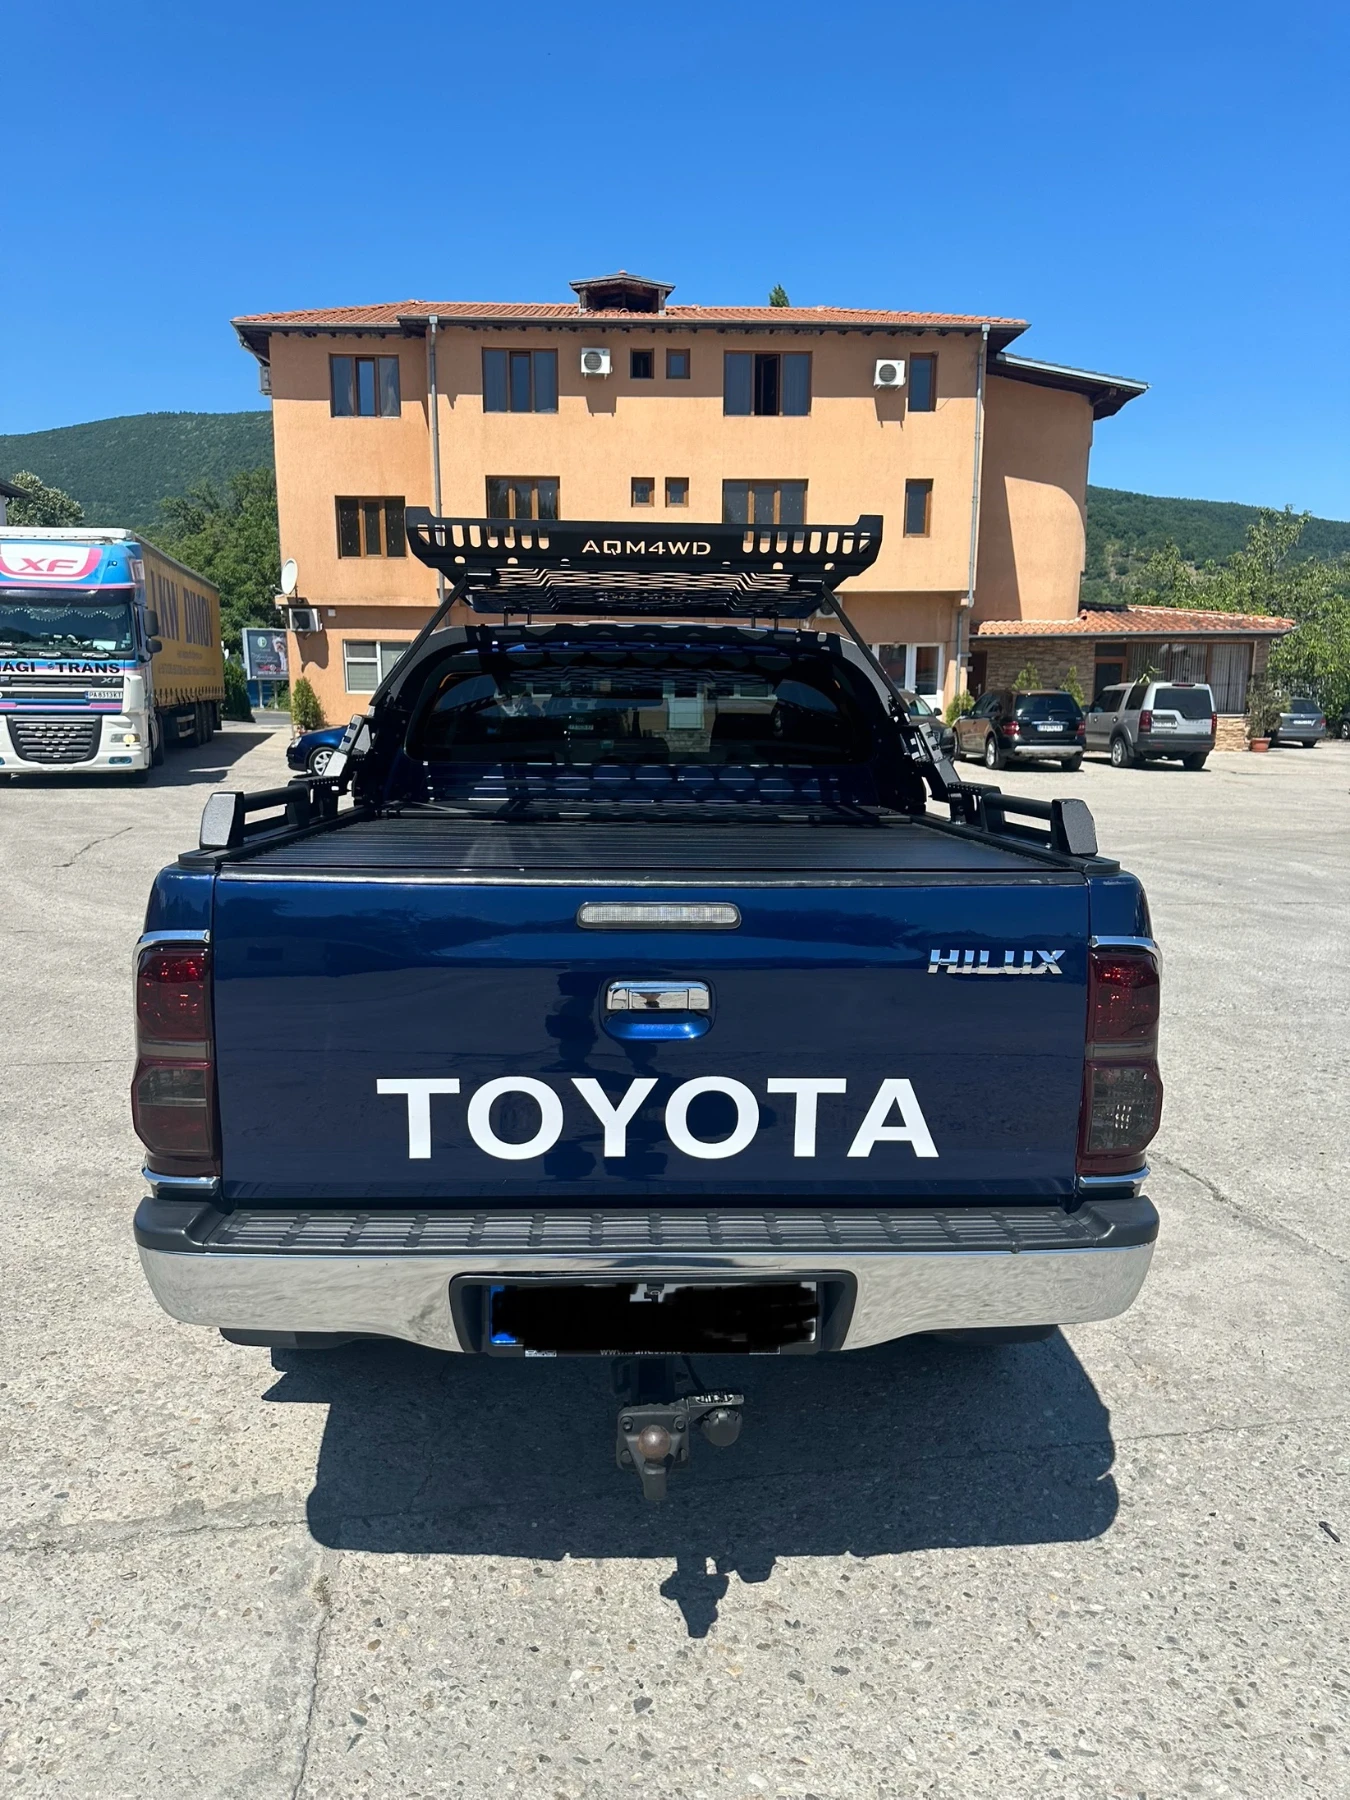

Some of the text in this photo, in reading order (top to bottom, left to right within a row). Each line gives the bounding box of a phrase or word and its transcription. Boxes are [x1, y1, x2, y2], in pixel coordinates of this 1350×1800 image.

[582, 540, 711, 555] AQM4WD
[18, 558, 78, 572] XF
[0, 661, 121, 674] AGI TRANS
[928, 949, 1066, 974] HILUX
[376, 1076, 940, 1160] TOYOTA
